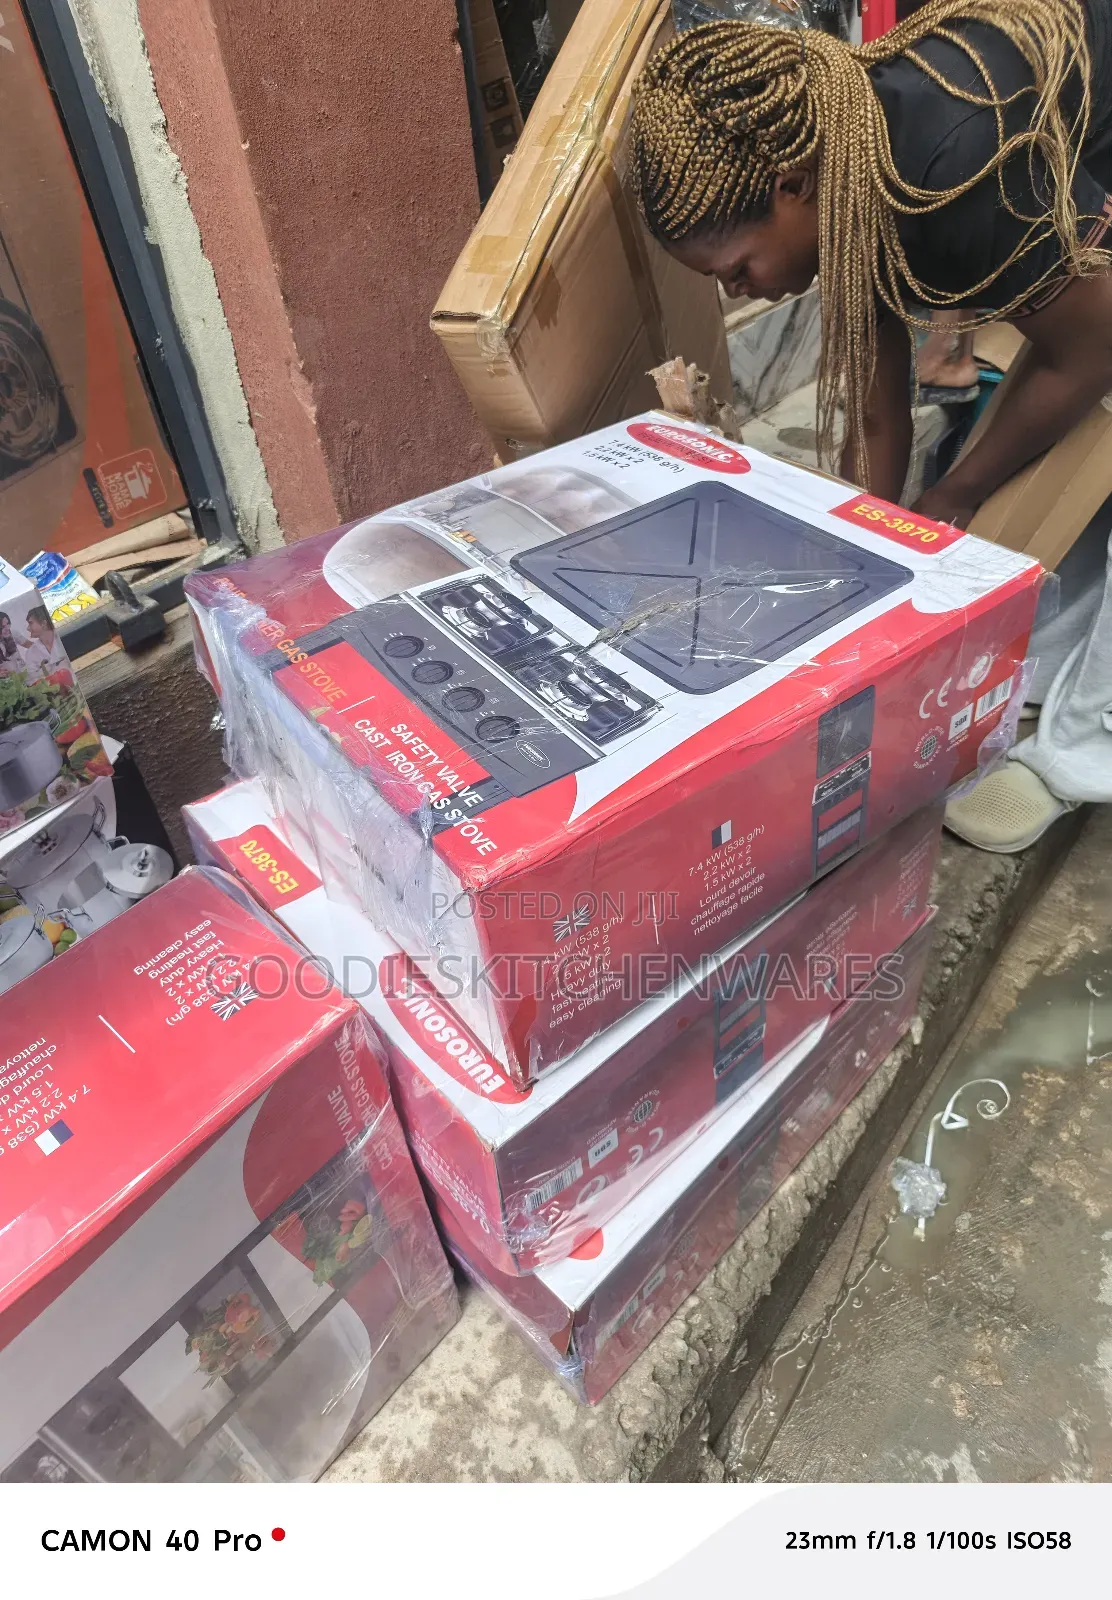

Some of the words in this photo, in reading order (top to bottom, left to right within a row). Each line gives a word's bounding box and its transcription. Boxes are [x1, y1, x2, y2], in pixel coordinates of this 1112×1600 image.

[645, 425, 735, 464] EUROSONIC
[659, 461, 685, 474] g/h)
[105, 475, 125, 511] HOME
[113, 471, 132, 508] MAMA
[852, 503, 939, 543] ES-3870
[276, 638, 308, 664] GAS
[300, 661, 347, 703] STOVE
[390, 723, 444, 767] SAFETY
[436, 765, 484, 808] VALVE
[354, 719, 392, 749] CAST
[385, 750, 425, 783] IRON
[417, 781, 451, 810] GAS
[444, 808, 498, 857] STOVE
[688, 862, 704, 877] 7.4
[706, 850, 722, 867] kW
[724, 836, 745, 857] (538
[746, 824, 765, 843] g/h)
[703, 865, 718, 881] 2.2
[720, 854, 735, 870] kW
[737, 851, 743, 859] x
[745, 844, 752, 854] 2
[239, 839, 299, 894] ES-3870
[704, 878, 719, 892] 1.5
[721, 866, 736, 882] kW
[737, 863, 744, 871] x
[745, 856, 752, 866] 2
[690, 892, 736, 926] chauffage
[738, 872, 765, 895] rapide
[699, 884, 727, 908] Lourd
[728, 866, 757, 889] devoir
[694, 903, 738, 936] nettoyage
[740, 885, 764, 905] facile
[184, 919, 212, 940] easy
[192, 930, 217, 949] fast
[553, 943, 572, 960] kW
[575, 927, 600, 949] (538
[602, 913, 624, 933] g/h)
[133, 939, 183, 976] cleaning
[148, 947, 194, 979] heating
[186, 939, 225, 968] Heavy
[573, 945, 590, 963] kW
[593, 941, 600, 950] x
[602, 934, 610, 945] 2
[574, 956, 592, 975] kW
[595, 953, 601, 963] x
[604, 946, 611, 957] 2
[159, 966, 185, 987] duty
[187, 965, 207, 983] kW
[216, 958, 238, 975] 2.2
[221, 969, 243, 988] kW
[550, 976, 585, 1001] Heavy
[588, 960, 611, 979] duty
[165, 987, 177, 997] 2
[175, 980, 186, 989] x
[185, 988, 194, 997] x
[192, 983, 221, 1008] (538
[196, 974, 217, 991] kW
[552, 996, 573, 1014] fast
[575, 971, 614, 999] heating
[165, 1004, 192, 1026] g/h)
[174, 995, 186, 1006] 2
[549, 1009, 575, 1029] easy
[578, 979, 622, 1012] cleaning
[395, 977, 506, 1094] EUROSONIC
[0, 1044, 58, 1089] chauffag
[12, 1063, 54, 1096] Lourd
[31, 1080, 54, 1099] 1.5
[39, 1087, 63, 1108] 2.2
[68, 1084, 91, 1104] 7.4
[350, 1076, 371, 1108] GAS
[7, 1096, 31, 1118] kW
[15, 1106, 39, 1128] kW
[43, 1101, 67, 1124] kW
[327, 1084, 353, 1127] VALVE
[1, 1125, 12, 1135] x
[7, 1120, 41, 1149] (538
